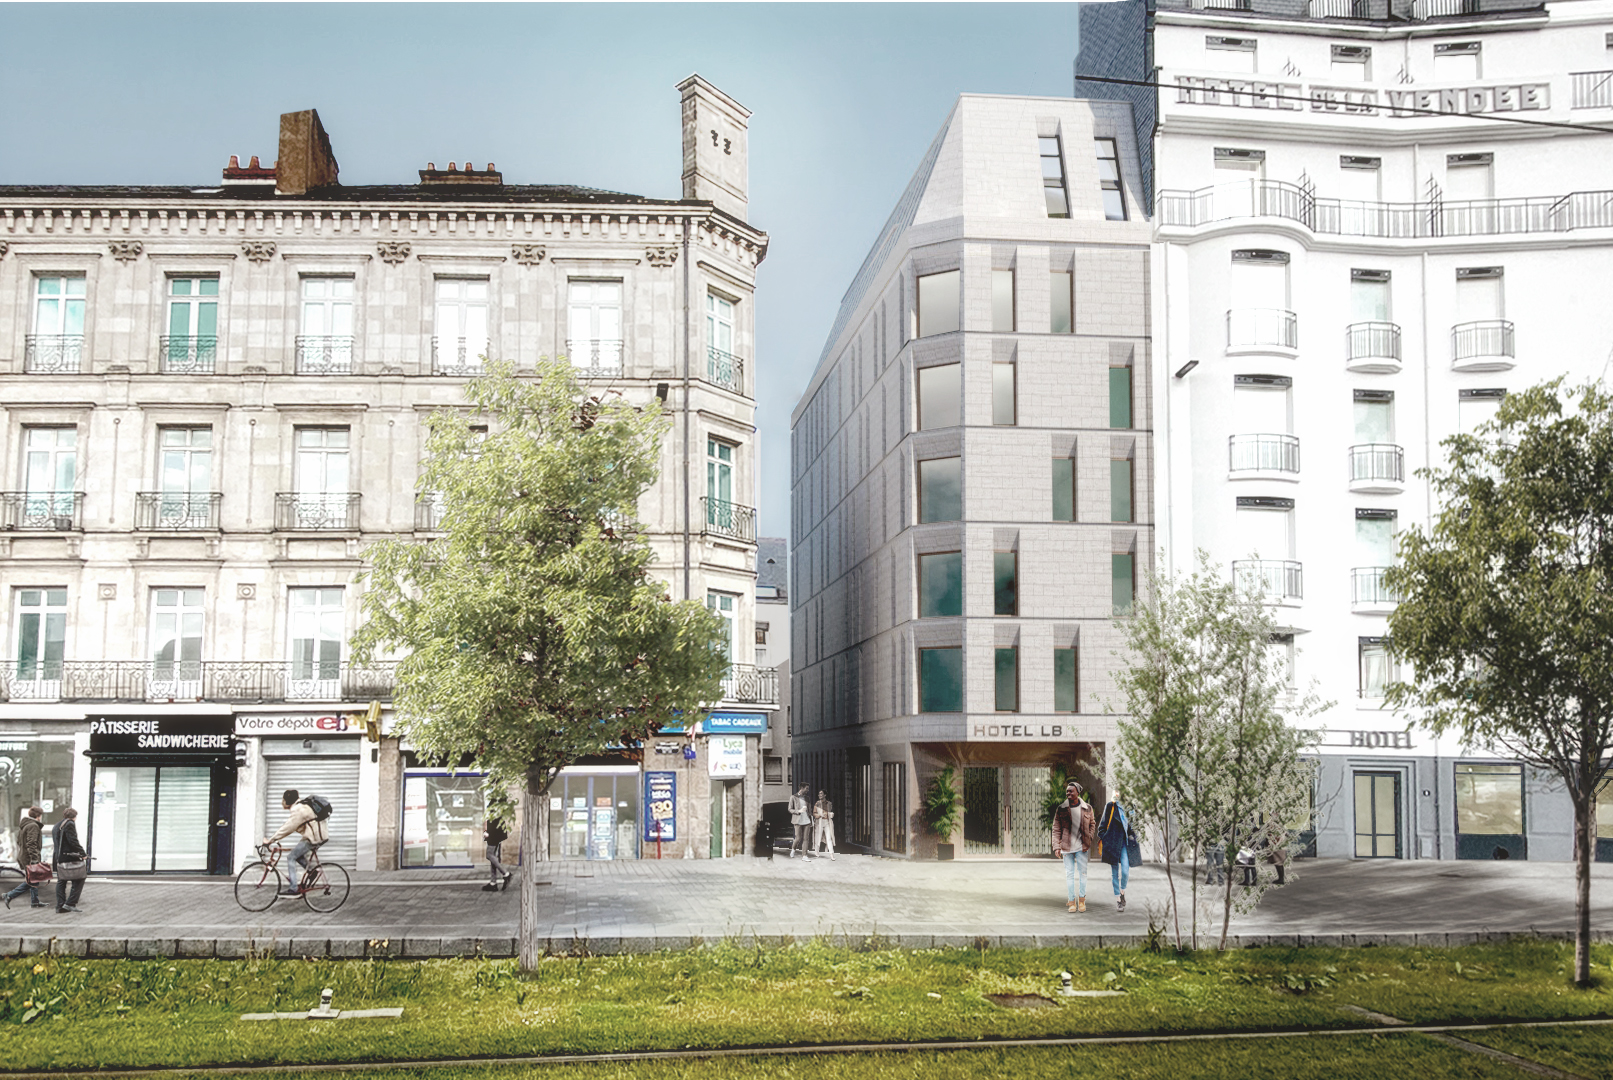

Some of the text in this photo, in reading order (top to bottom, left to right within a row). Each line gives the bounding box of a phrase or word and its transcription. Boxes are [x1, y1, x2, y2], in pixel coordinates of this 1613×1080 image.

[1177, 76, 1542, 117] HOTEL DE LA VENDEE
[90, 718, 160, 734] PÂTISSERIE
[239, 717, 274, 729] Votre
[277, 716, 314, 731] dépôt
[711, 718, 762, 726] TABAC CADEAUX
[974, 725, 1062, 737] HOTEL LB
[137, 734, 229, 748] SANDWICHERIE
[723, 738, 743, 750] Lyca
[1350, 731, 1412, 749] HOTEL
[649, 800, 673, 814] 130
